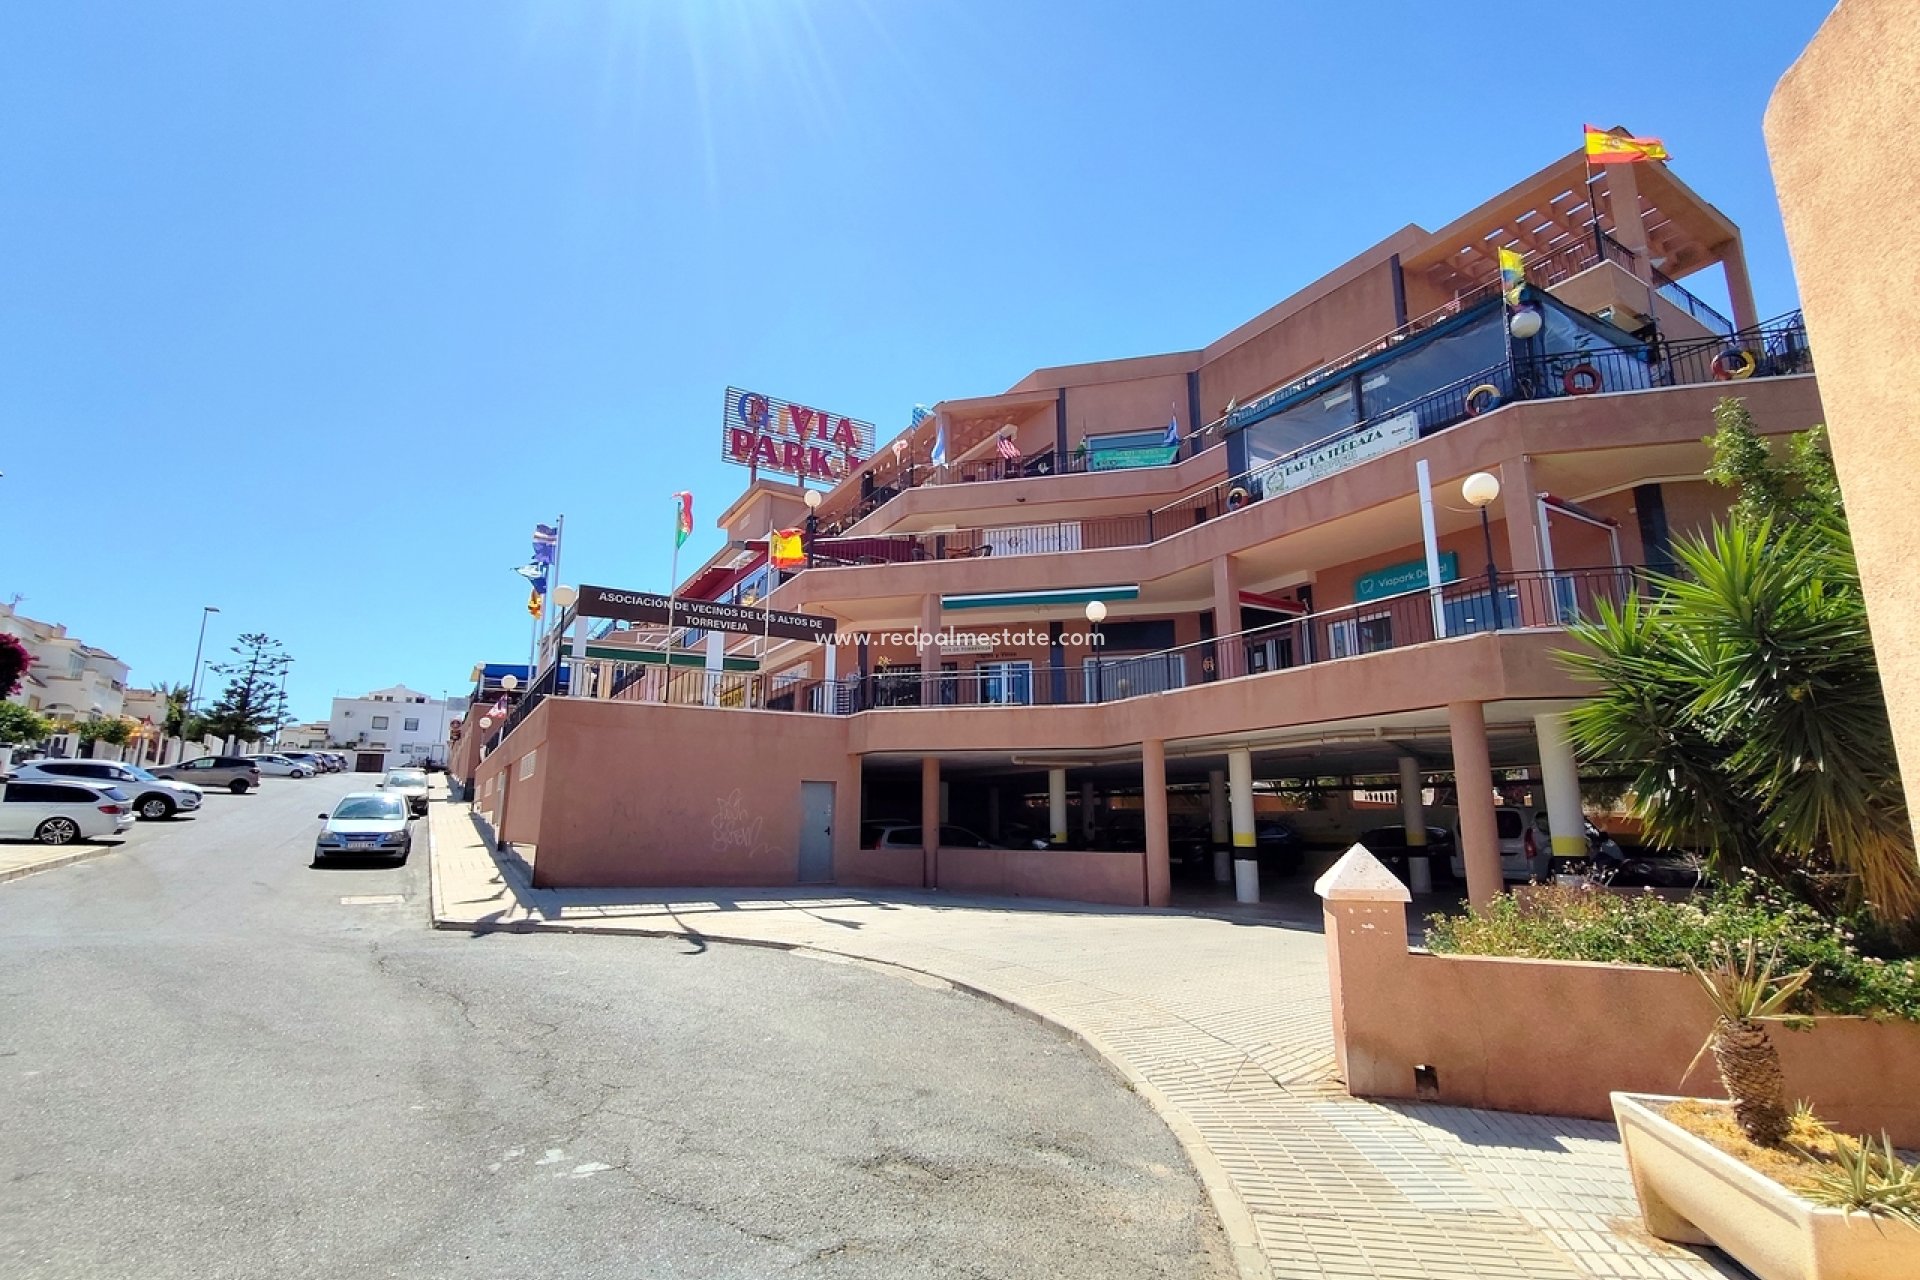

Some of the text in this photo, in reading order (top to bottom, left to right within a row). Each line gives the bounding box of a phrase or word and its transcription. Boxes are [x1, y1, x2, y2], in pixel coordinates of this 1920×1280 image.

[788, 404, 856, 447] VIA
[730, 428, 833, 477] PARK
[1309, 454, 1325, 467] LA
[1327, 430, 1384, 459] TERRAZA
[1378, 571, 1415, 587] Viapark
[1416, 563, 1447, 578] Deal
[599, 591, 823, 629] ASOCIACIÓN DE VECINOS DE LOS ALTOS DE
[685, 616, 748, 631] TORREVIEJA
